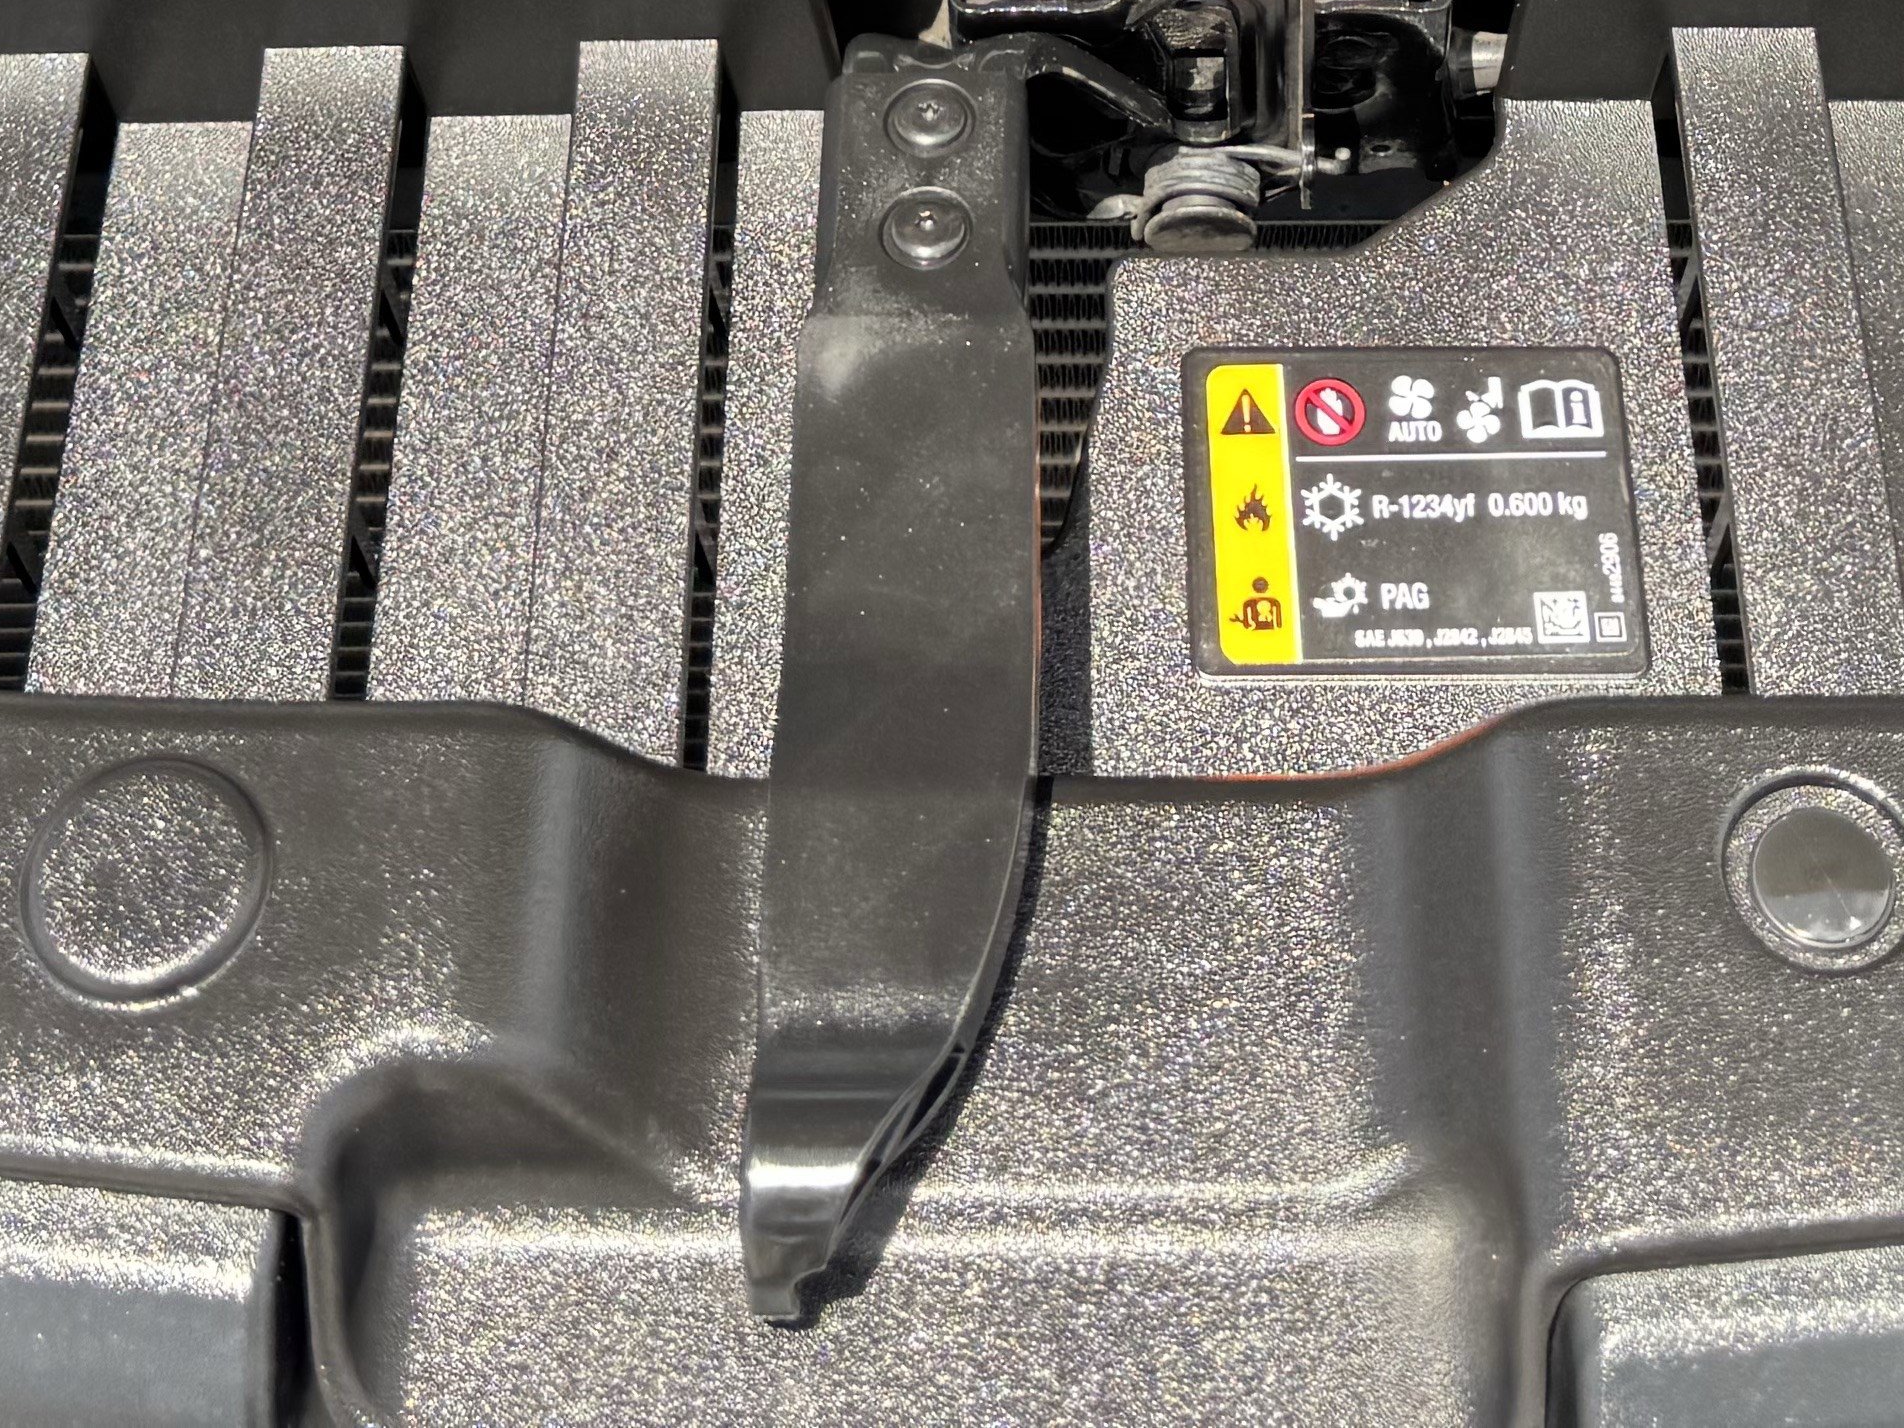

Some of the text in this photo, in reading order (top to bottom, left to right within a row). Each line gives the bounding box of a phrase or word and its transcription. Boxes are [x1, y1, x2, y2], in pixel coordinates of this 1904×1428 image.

[1388, 420, 1442, 443] AUTO
[1372, 490, 1588, 523] R-1234yf 0.600 kg
[1380, 581, 1431, 611] PAG
[1354, 629, 1386, 648] SAE
